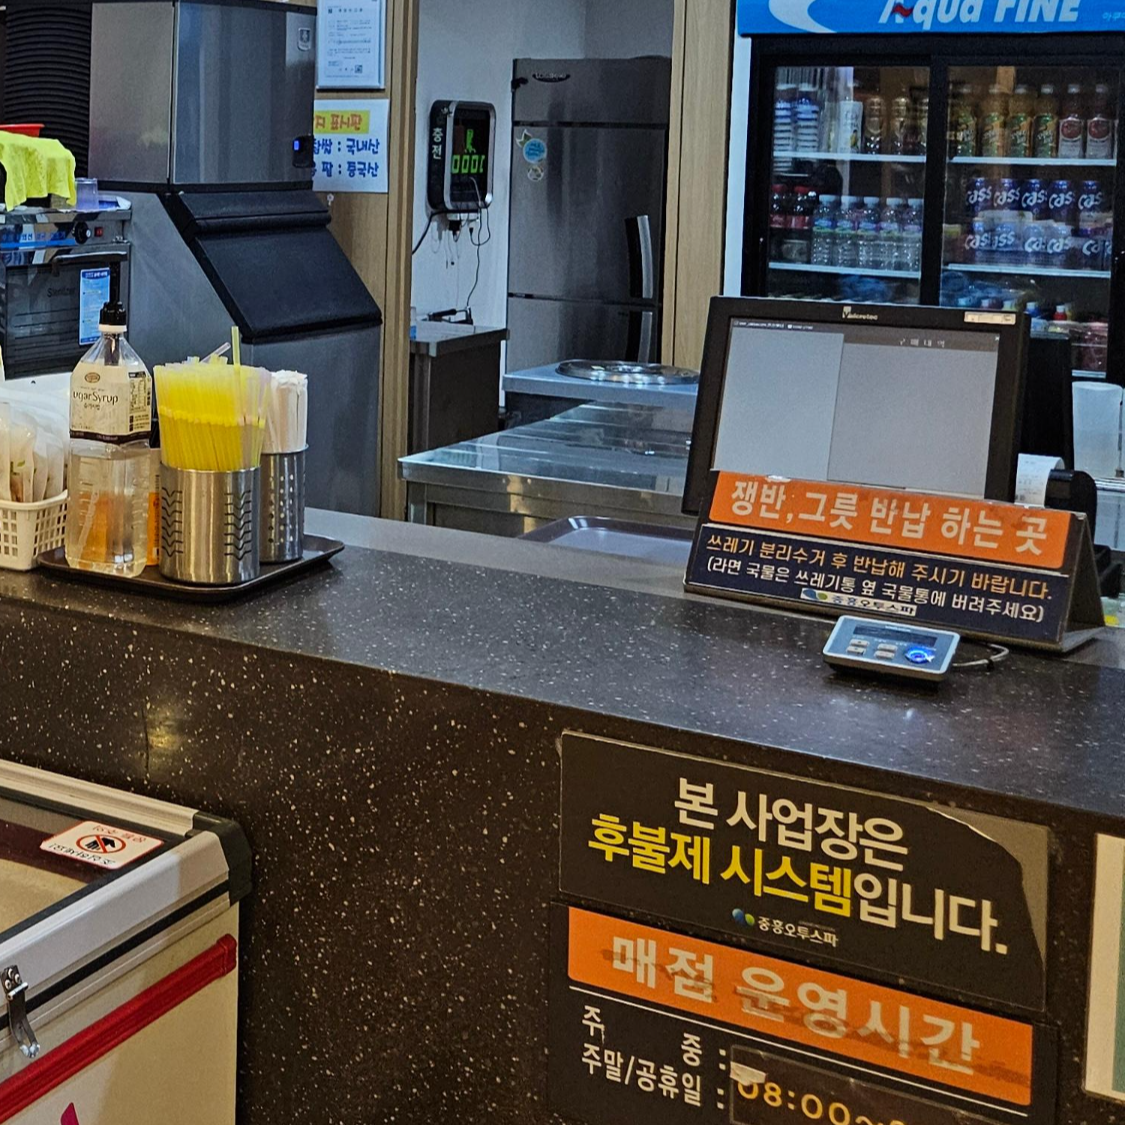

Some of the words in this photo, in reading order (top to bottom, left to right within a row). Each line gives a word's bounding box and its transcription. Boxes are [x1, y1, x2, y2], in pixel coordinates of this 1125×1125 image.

[346, 137, 380, 155] 국내산
[347, 161, 379, 178] 중국산
[870, 497, 931, 539] 반납
[941, 504, 1004, 550] 하는
[1015, 516, 1048, 557] 곳
[706, 534, 754, 557] 쓰레기
[760, 541, 825, 568] 분리수거
[831, 552, 849, 569] 후
[853, 555, 905, 578] 반납해
[911, 565, 966, 588] 주시기
[971, 572, 1052, 600] 바랍니다.
[707, 556, 742, 577] (라면
[746, 563, 791, 583] 국물은
[795, 569, 856, 594] 쓰레기통
[861, 580, 876, 598] 옆
[882, 582, 946, 608] 국물통에
[951, 589, 1044, 623] 버려주세요)
[674, 777, 719, 830] 본
[726, 789, 909, 872] 사업장은
[588, 812, 711, 885] 후불제
[720, 844, 1009, 956] 시스템입니다.
[757, 914, 840, 948] 중흥오투스파
[612, 934, 716, 1004] 매점
[733, 964, 982, 1077] 운영시간
[581, 1043, 703, 1107] 주말/공휴일
[736, 1079, 909, 1125] 08:00~
